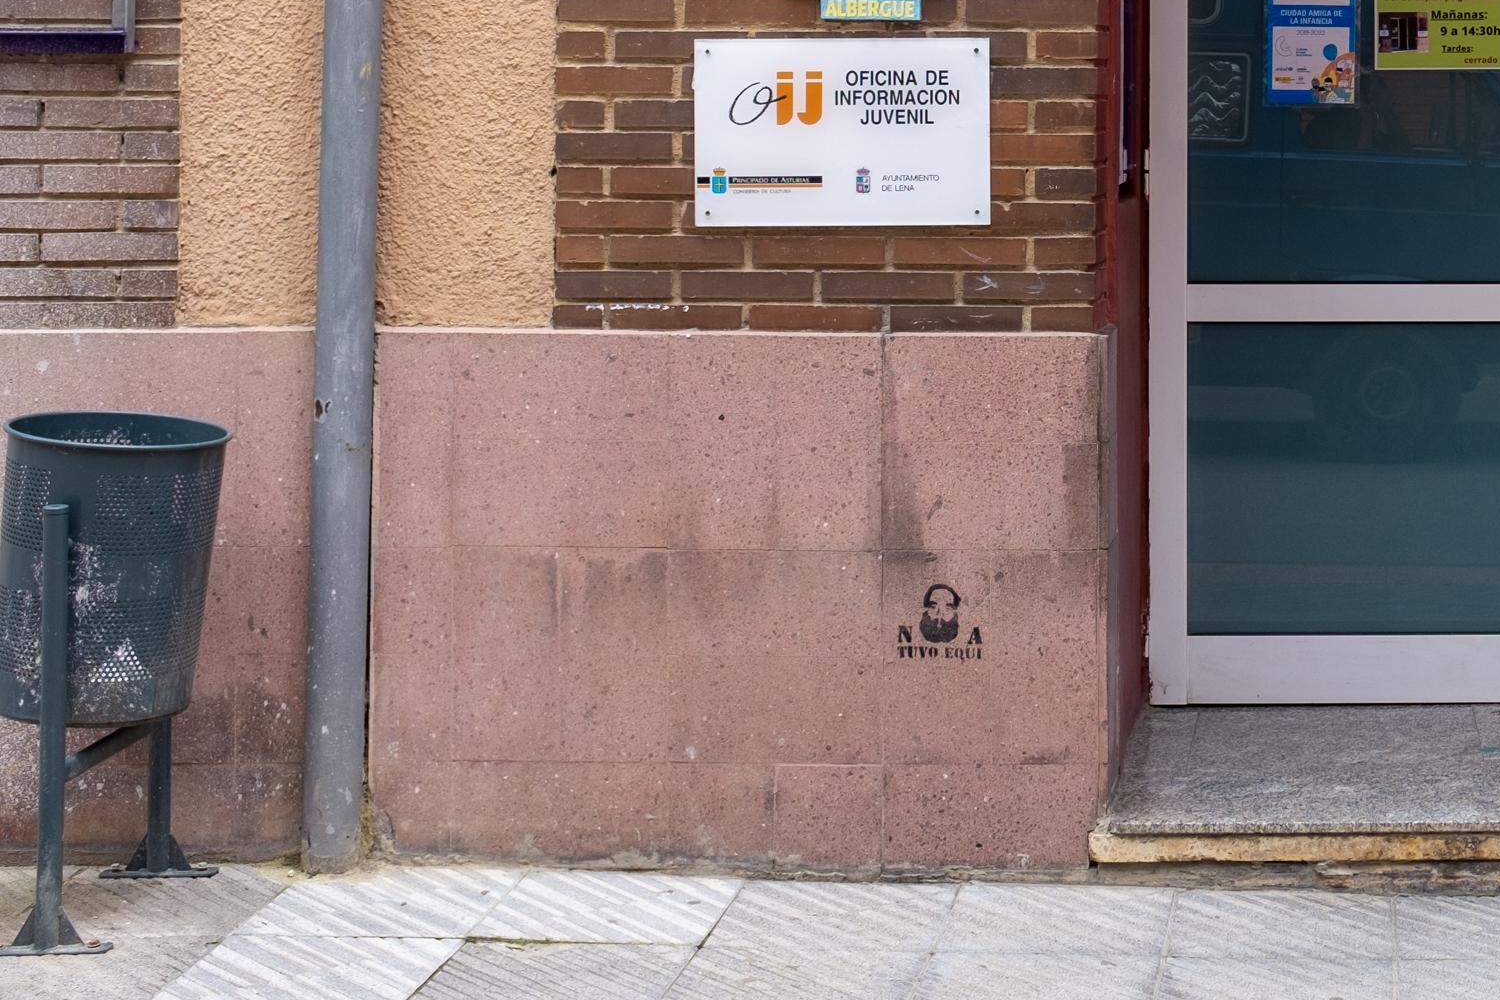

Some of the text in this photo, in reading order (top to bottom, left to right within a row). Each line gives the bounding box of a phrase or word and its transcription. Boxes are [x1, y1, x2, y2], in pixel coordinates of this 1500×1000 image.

[825, 0, 915, 18] ALBERGUE
[1280, 9, 1344, 17] CIUDAD AMIGA DE
[1431, 10, 1488, 20] Mañanas:
[1440, 26, 1447, 36] 9
[1450, 28, 1458, 36] a
[1464, 56, 1498, 64] cerrado
[846, 70, 950, 87] OFICINA DE
[835, 89, 960, 106] INFORMACION
[860, 109, 935, 126] JUVENIL
[732, 176, 769, 184] PRINCIPADO
[780, 176, 810, 184] ASTURIAS
[881, 174, 940, 182] AYUNTAMIENTO
[881, 184, 916, 192] DE LENA
[896, 646, 983, 661] TUVO EQUI
